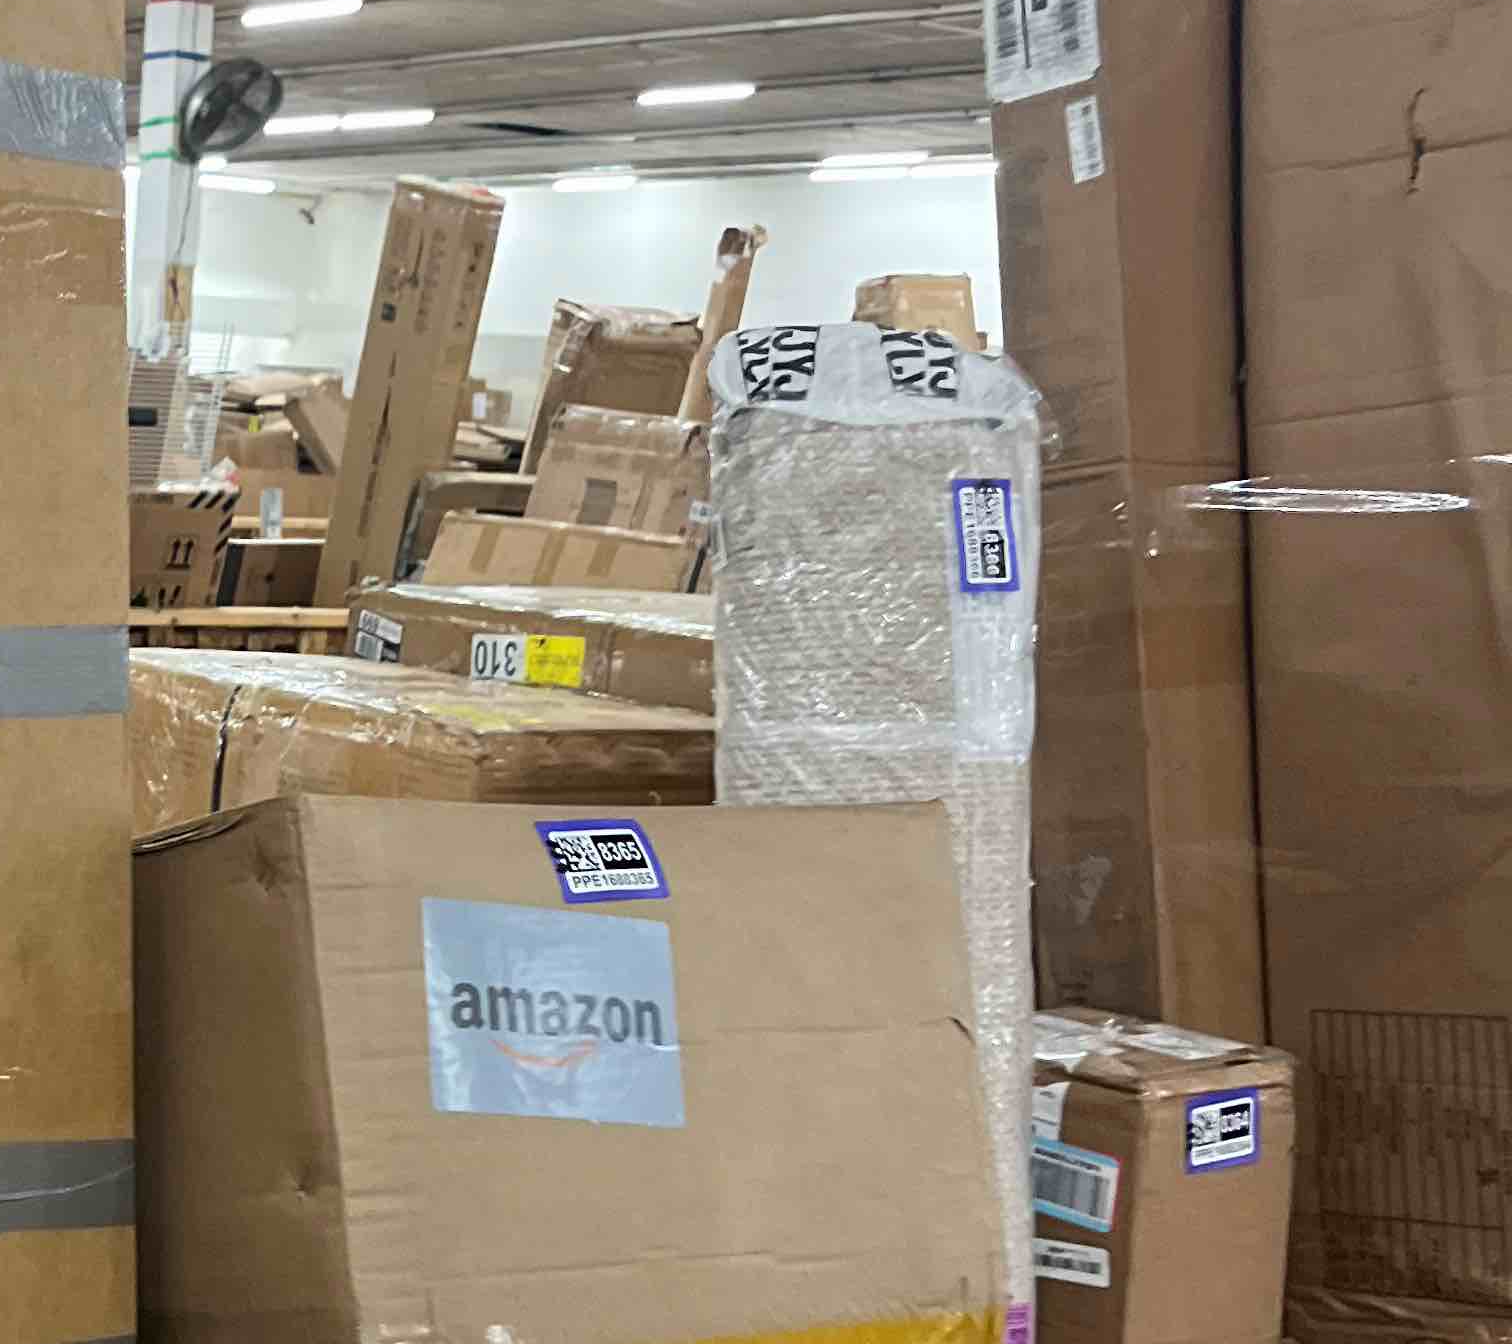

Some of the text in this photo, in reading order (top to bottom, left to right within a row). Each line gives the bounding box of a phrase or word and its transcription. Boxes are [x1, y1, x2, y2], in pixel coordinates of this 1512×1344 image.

[474, 640, 520, 677] 310
[596, 841, 642, 862] 8365
[449, 981, 665, 1046] amazon
